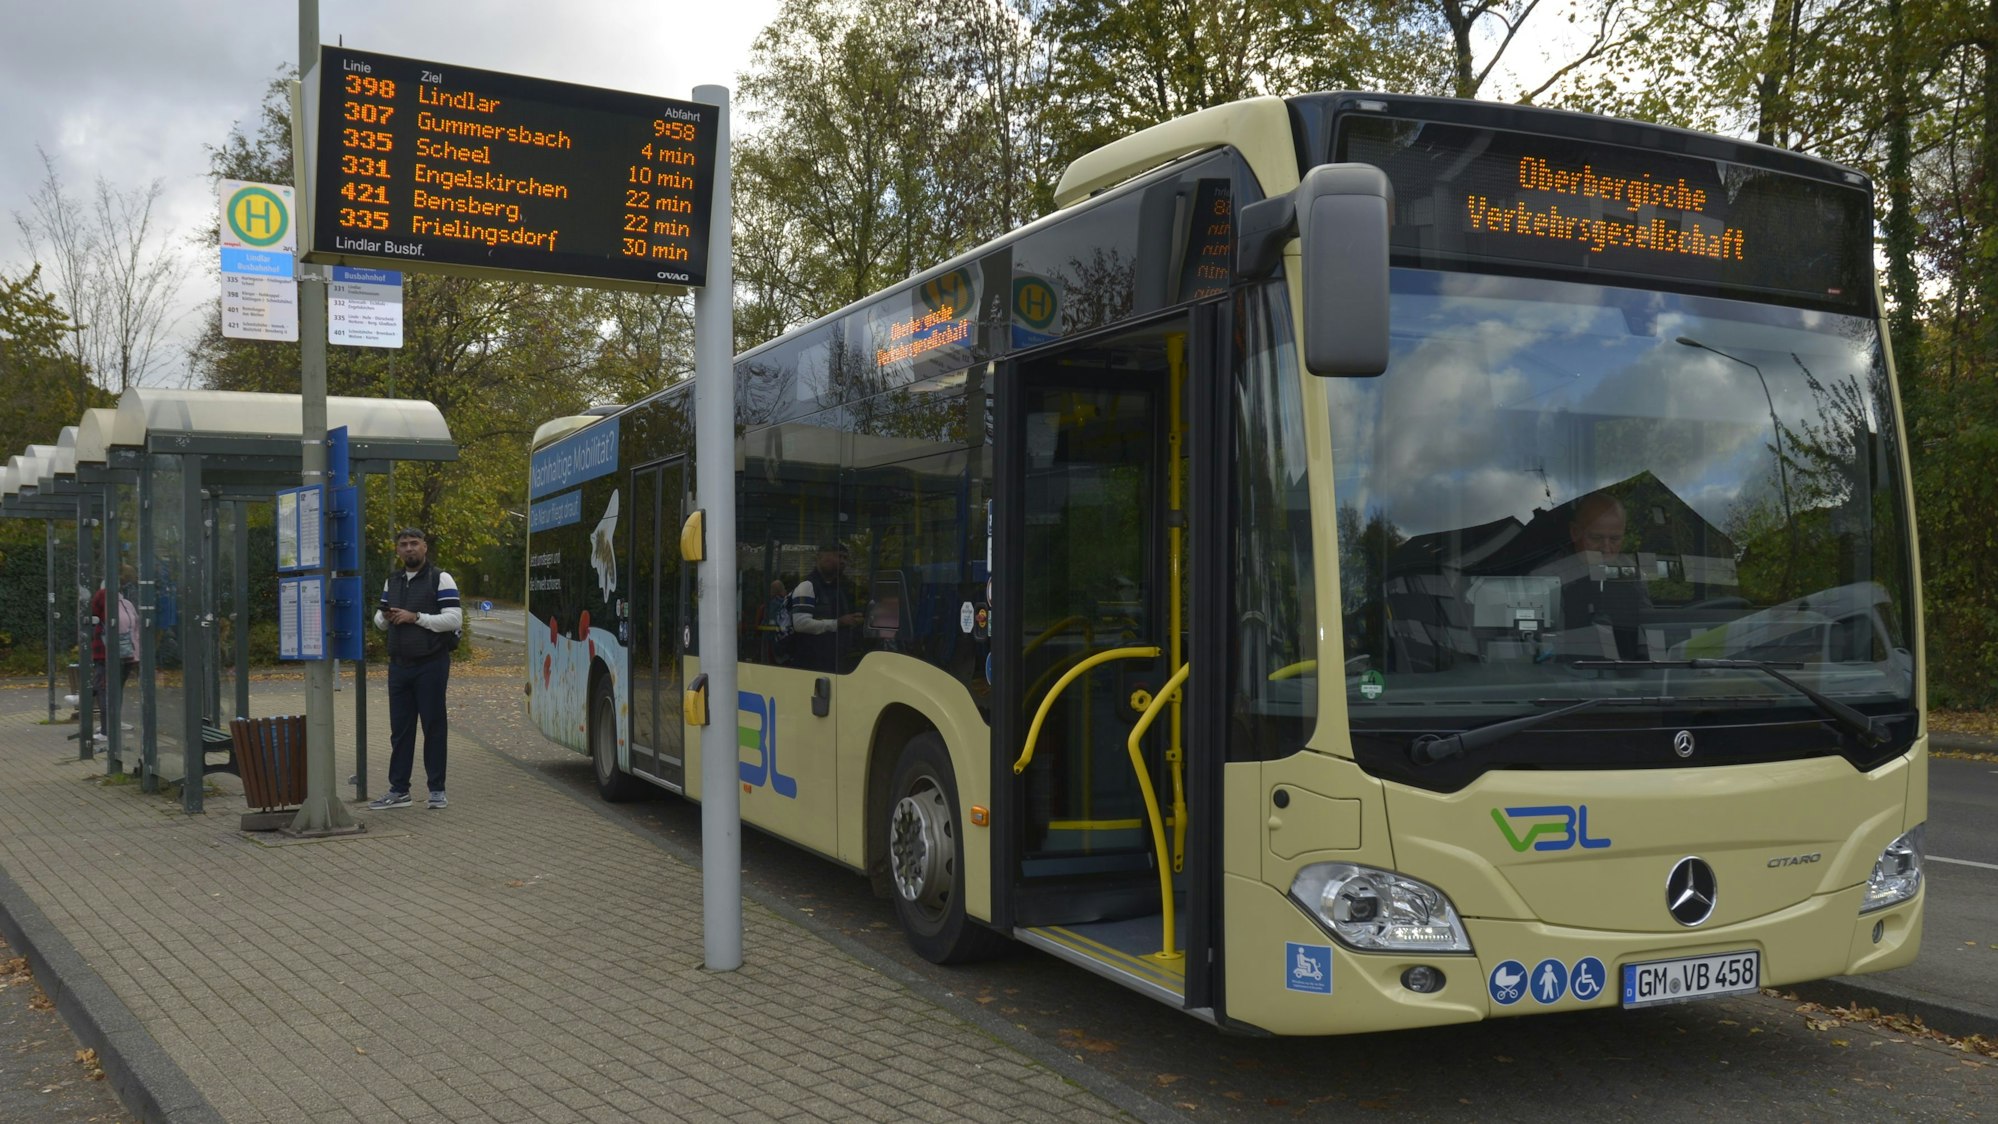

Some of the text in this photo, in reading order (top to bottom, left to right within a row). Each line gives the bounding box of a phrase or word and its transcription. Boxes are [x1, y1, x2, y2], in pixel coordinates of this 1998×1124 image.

[343, 59, 700, 122] Linie Ziel Abfahrt
[346, 74, 696, 142] 398 Lindlar 9:58
[343, 128, 694, 190] 335 Scheel 10 min
[344, 101, 696, 166] 307 Gummersbach 4 min
[340, 182, 690, 238] 421 Bensberg 22 min
[342, 155, 692, 214] 331 Engelskirchen 22 min
[1519, 156, 1708, 214] Oberbergische
[336, 236, 425, 257] Lindlar Busbf.
[339, 208, 688, 262] 335 Frielingsdorf 30 min
[1467, 195, 1745, 261] Verkehrsgesellschaft
[344, 272, 386, 282] Busbahnhof
[657, 271, 689, 281] OVAG
[532, 430, 614, 488] Nachhaltige Mobilität?
[1368, 671, 1376, 685] 4
[1491, 805, 1612, 852] VBL
[1767, 853, 1822, 868] CITARO
[1626, 958, 1754, 998] D GM VB 458
